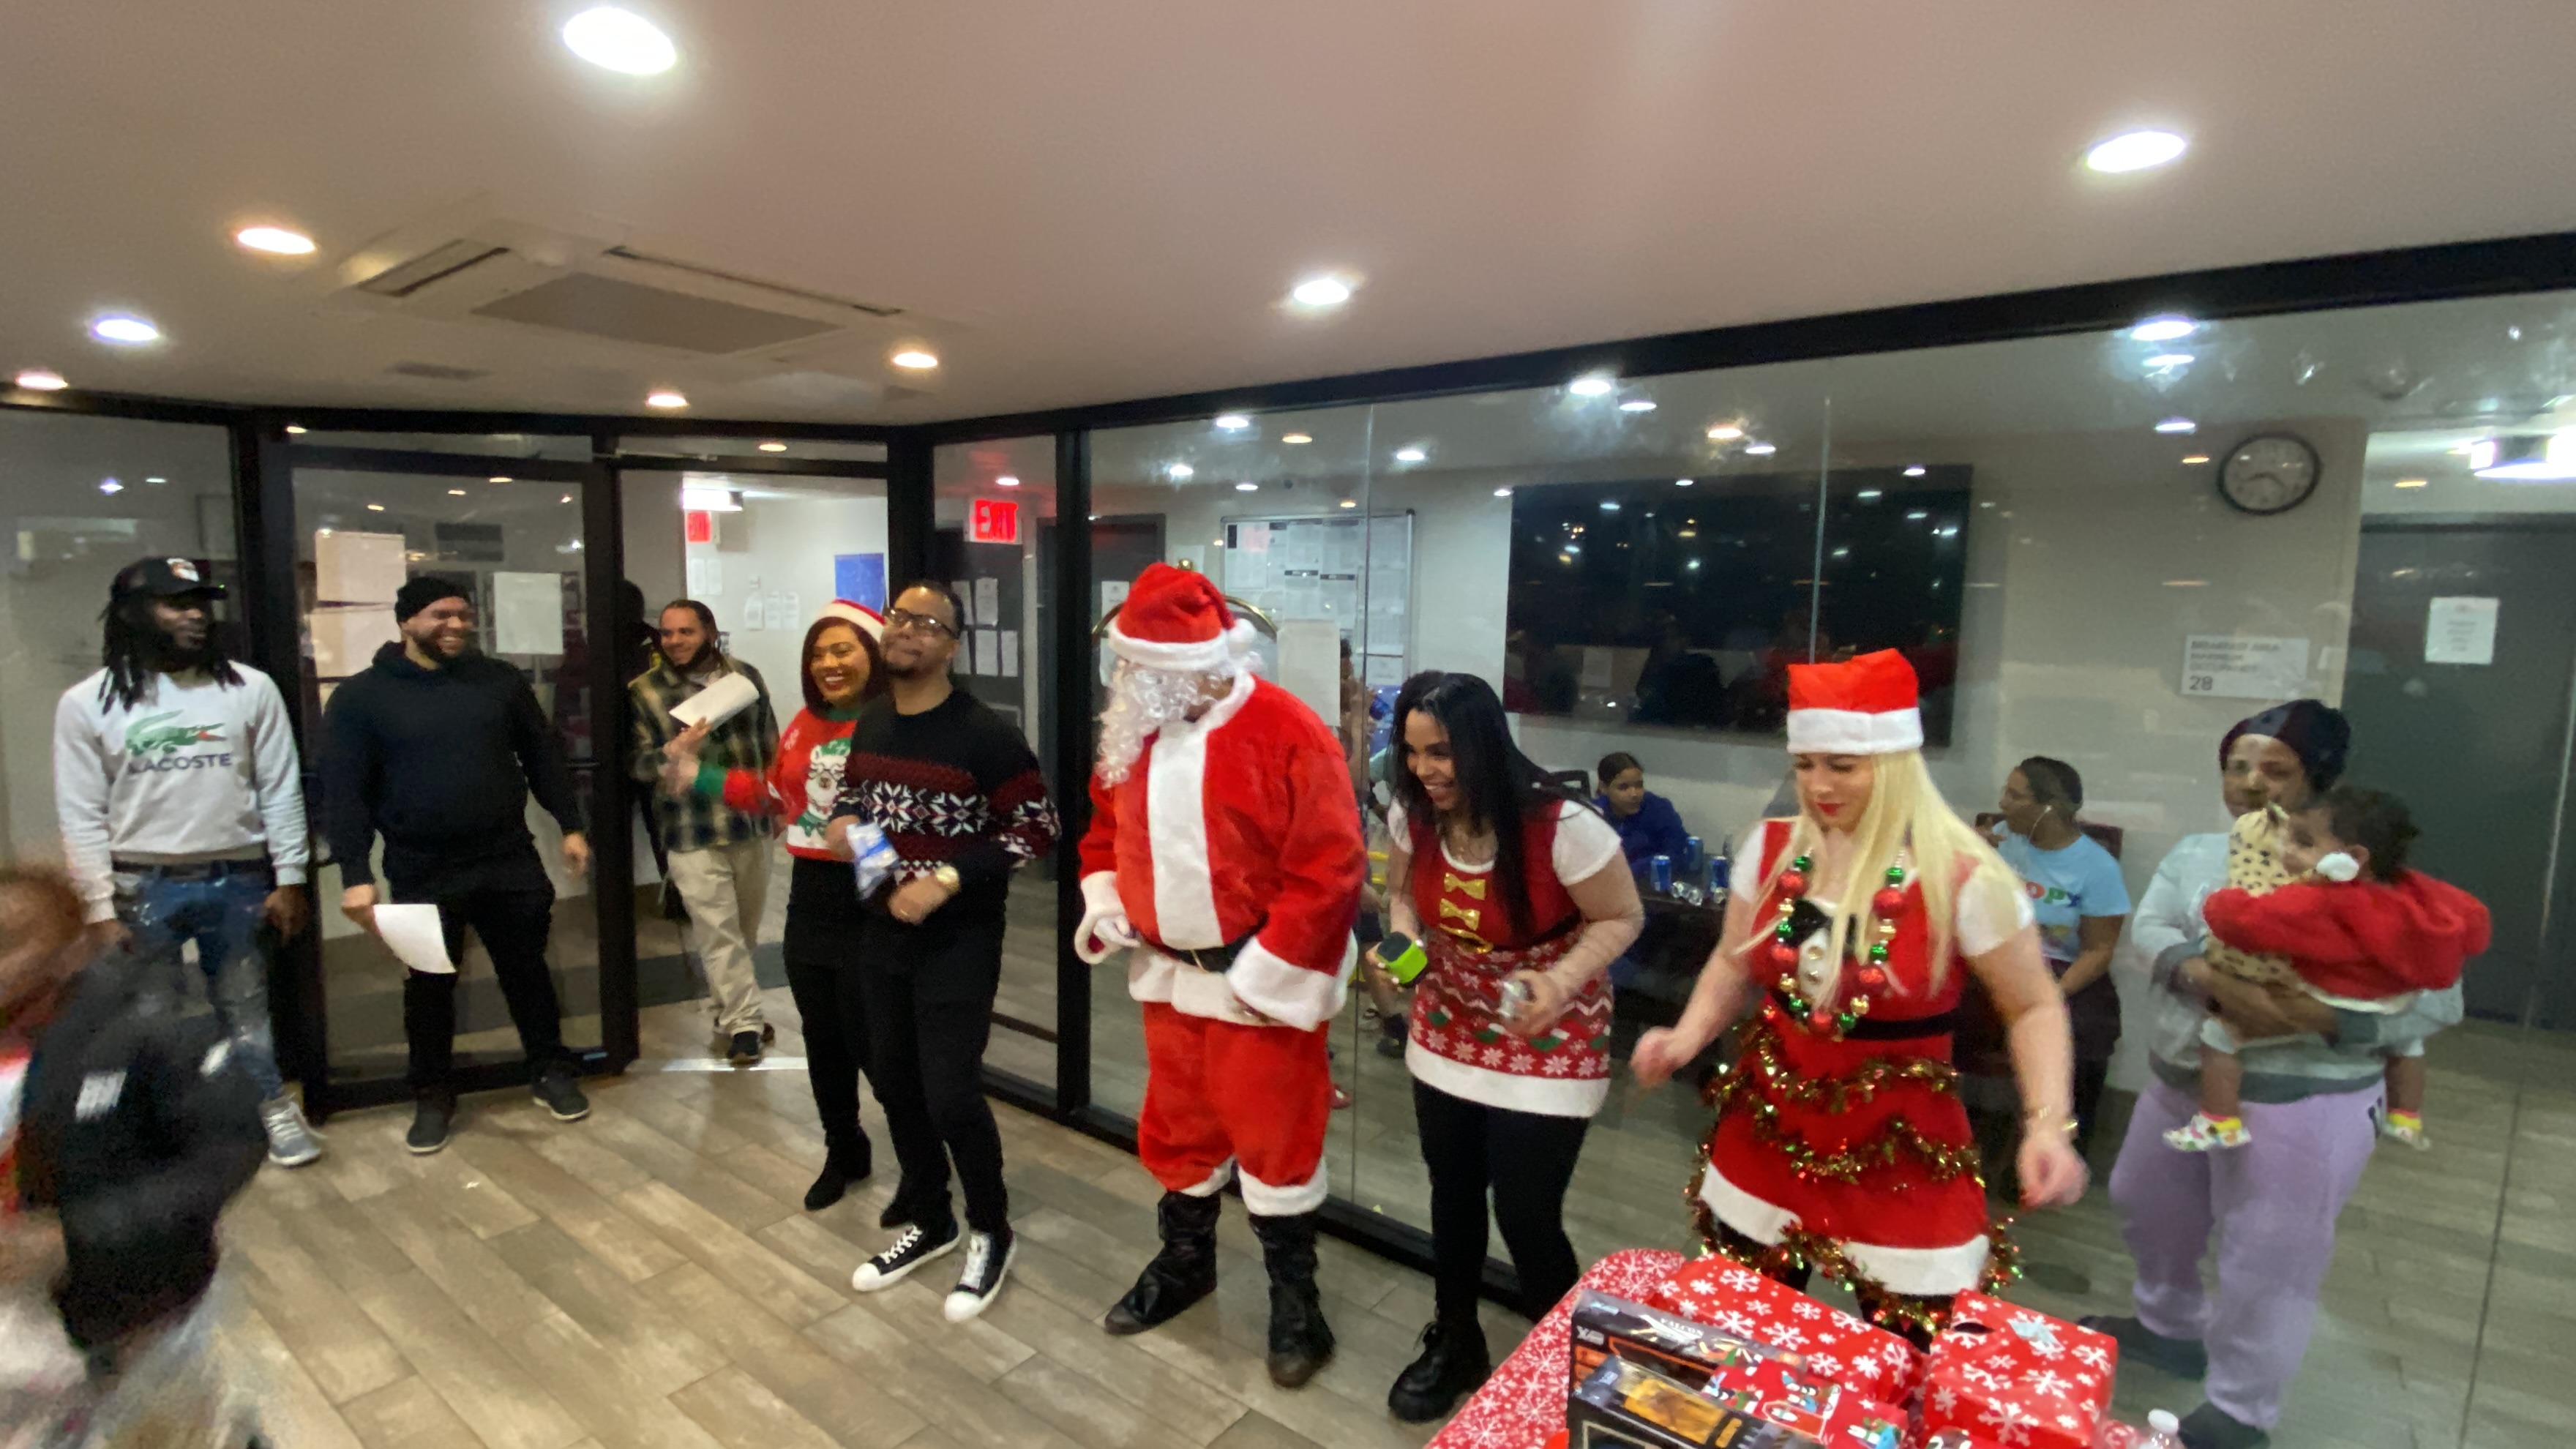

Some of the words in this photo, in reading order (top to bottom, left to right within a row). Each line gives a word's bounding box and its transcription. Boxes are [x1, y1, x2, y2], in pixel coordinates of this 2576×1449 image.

[974, 499, 1018, 542] EXIT
[2189, 675, 2213, 690] 28
[127, 753, 232, 774] LACOSTE
